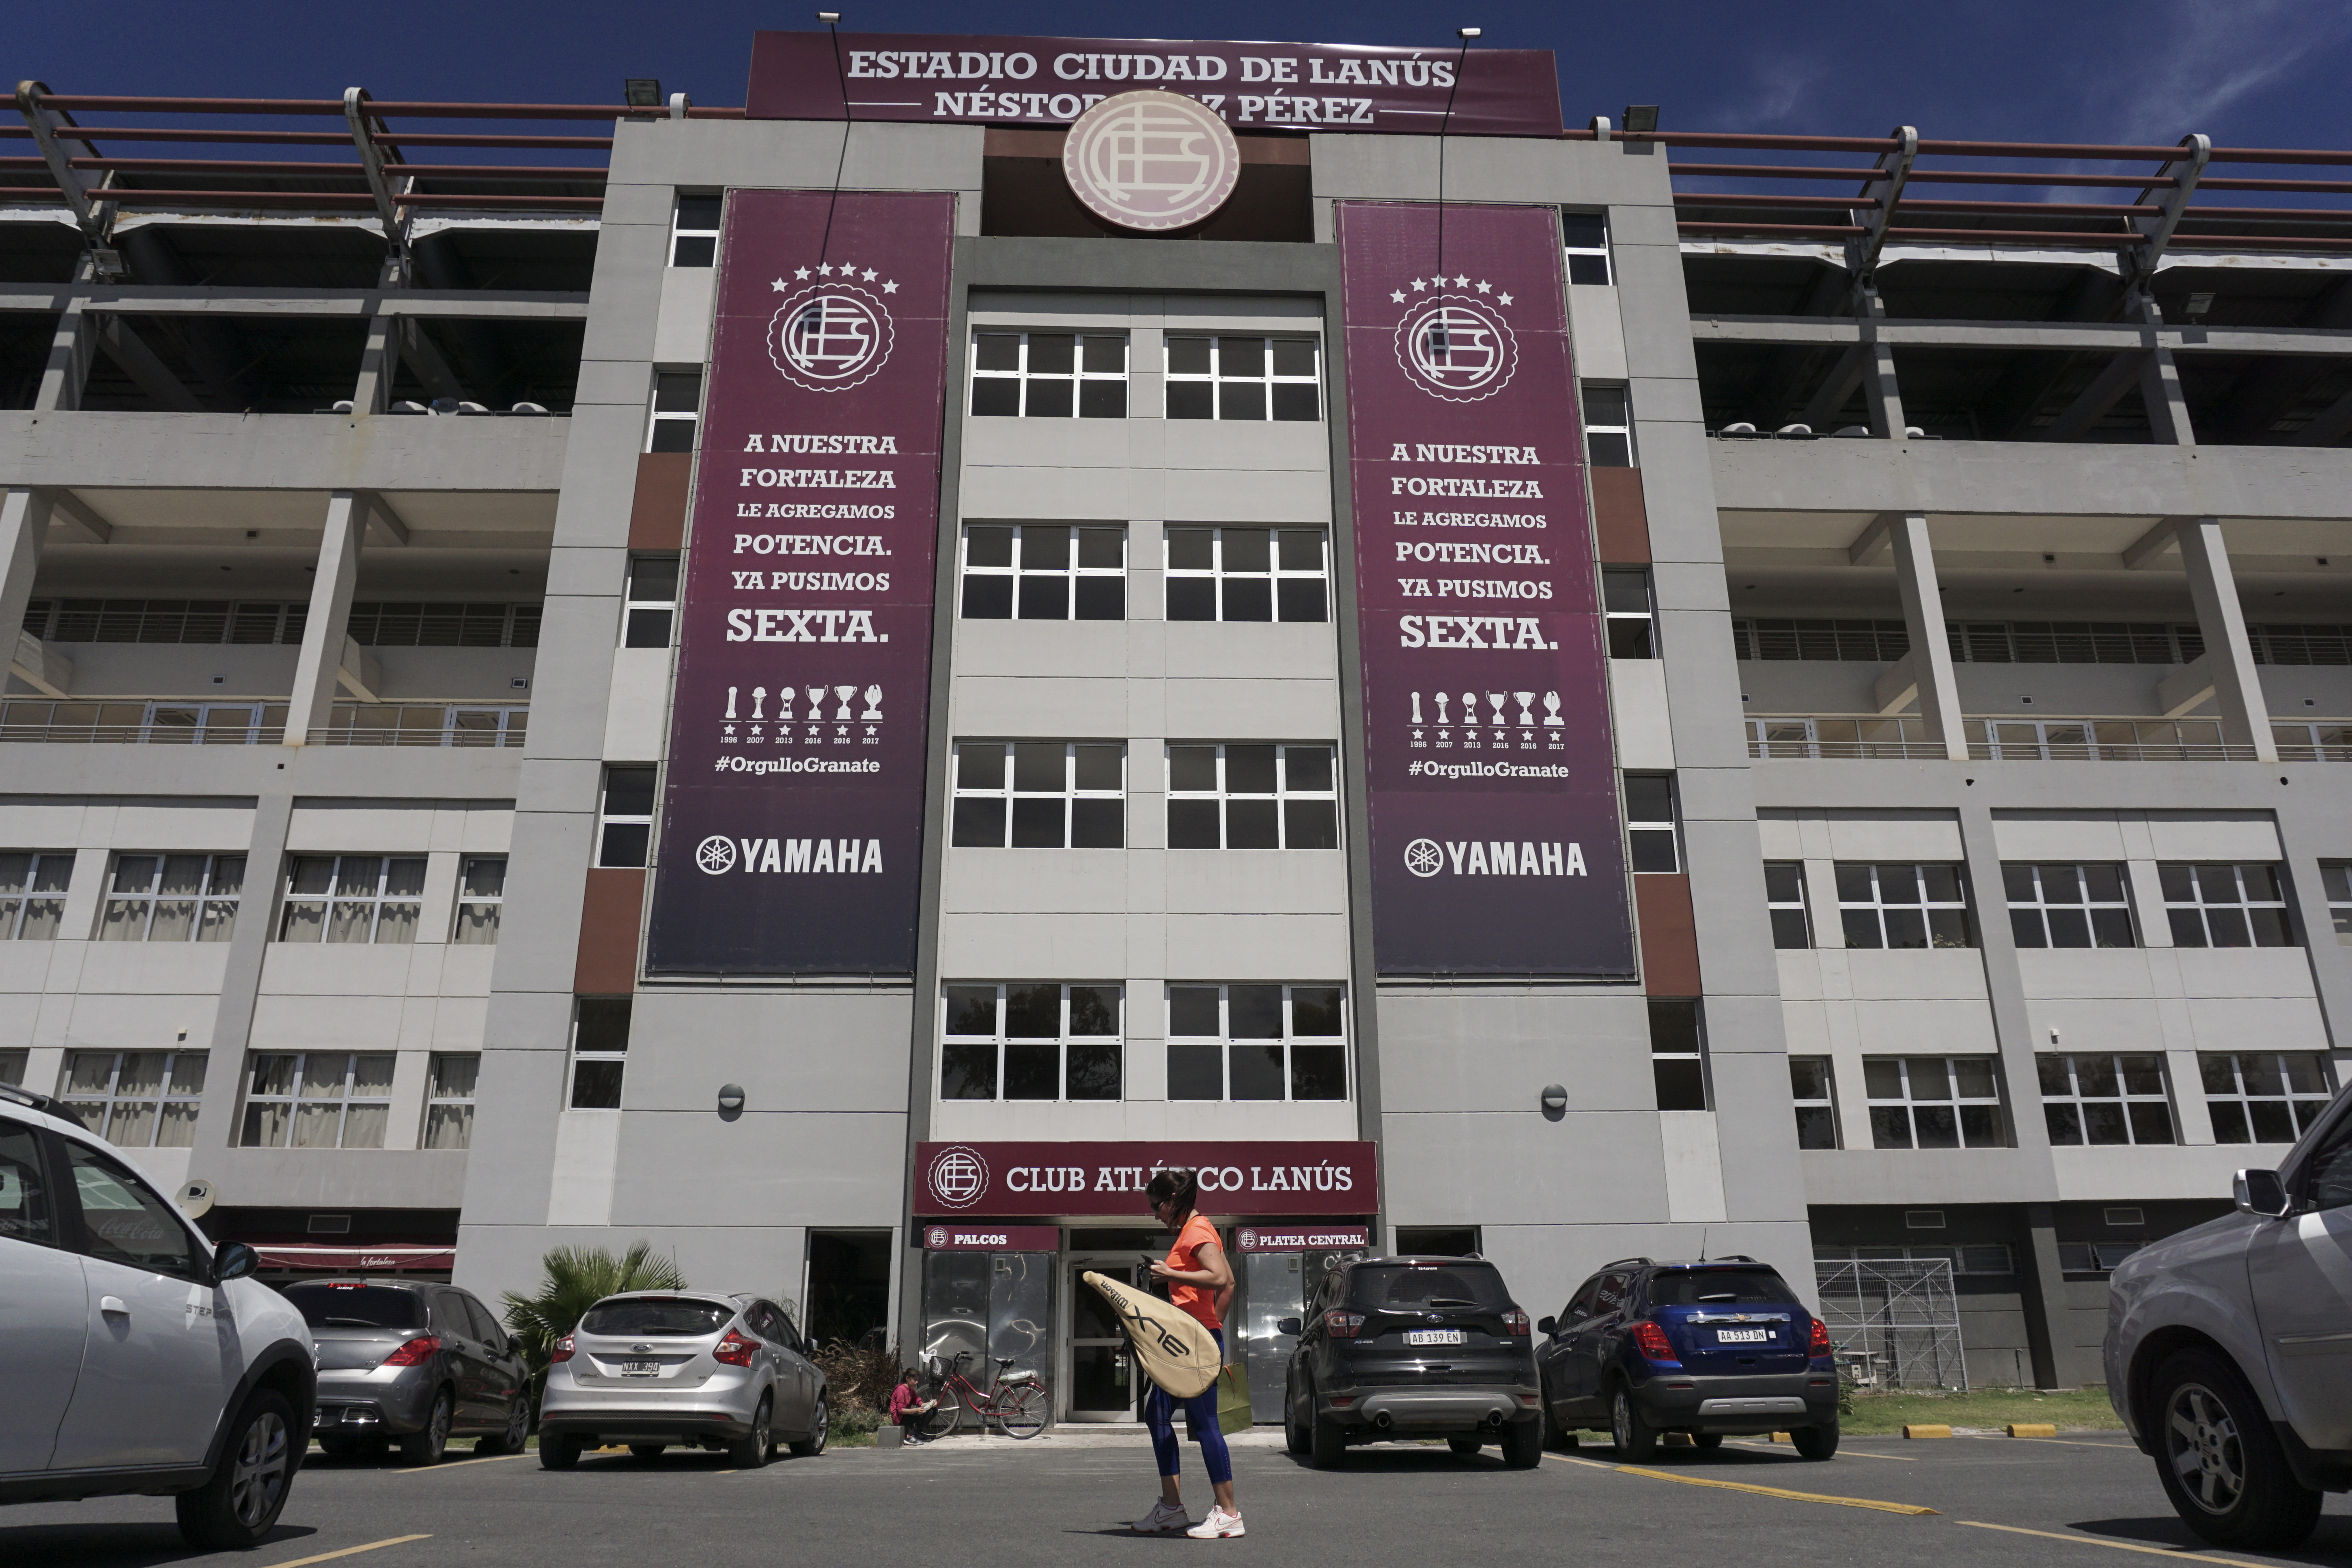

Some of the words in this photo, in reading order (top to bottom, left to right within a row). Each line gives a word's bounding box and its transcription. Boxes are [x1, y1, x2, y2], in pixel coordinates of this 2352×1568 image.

[848, 52, 1037, 79] ESTADIO
[1054, 54, 1227, 80] CIUDAD
[1241, 57, 1298, 82] DE
[1309, 53, 1455, 86] LANÚS
[1238, 88, 1373, 123] PÉREZ
[744, 435, 764, 452] A
[771, 435, 898, 454] NUESTRA
[1391, 444, 1411, 461] A
[1416, 444, 1540, 464] NUESTRA
[740, 469, 896, 488] FORTALEZA
[1391, 478, 1543, 498] FORTALEZA
[737, 504, 761, 517] LE
[765, 504, 894, 519] AGREGAMOS
[1394, 512, 1417, 525] LE
[1422, 513, 1546, 528] AGREGAMOS
[734, 534, 891, 555] POTENCIA.
[1396, 542, 1550, 564] POTENCIA.
[732, 572, 765, 589] YA
[771, 572, 889, 591] PUSIMOS
[1398, 579, 1432, 596] YA
[1437, 579, 1552, 599] PUSIMOS
[727, 609, 888, 642] SEXTA.
[1400, 615, 1558, 649] SEXTA.
[715, 756, 880, 775] #OrgulloGranate
[1409, 761, 1568, 779] #OrgulloGranate
[741, 839, 882, 872] YAMAHA
[1445, 842, 1587, 876] YAMAHA
[1007, 1167, 1085, 1191] CLUB
[1094, 1160, 1243, 1191] ATLCO
[1251, 1160, 1352, 1191] LANÚS
[954, 1235, 1006, 1244] PALCOS
[1260, 1236, 1305, 1245] PLATEA
[1308, 1235, 1364, 1245] CENTRAL
[360, 1256, 366, 1265] la
[366, 1256, 395, 1267] fortaleza
[1101, 1279, 1129, 1309] Wilson
[1126, 1304, 1190, 1357] BLX
[1413, 1334, 1424, 1343] AB
[1427, 1333, 1444, 1342] 139
[1447, 1333, 1459, 1342] EN
[1721, 1331, 1732, 1340] AA
[1734, 1331, 1750, 1340] 513
[1753, 1331, 1764, 1339] DN
[622, 1362, 638, 1371] NXX
[642, 1362, 658, 1371] 394
